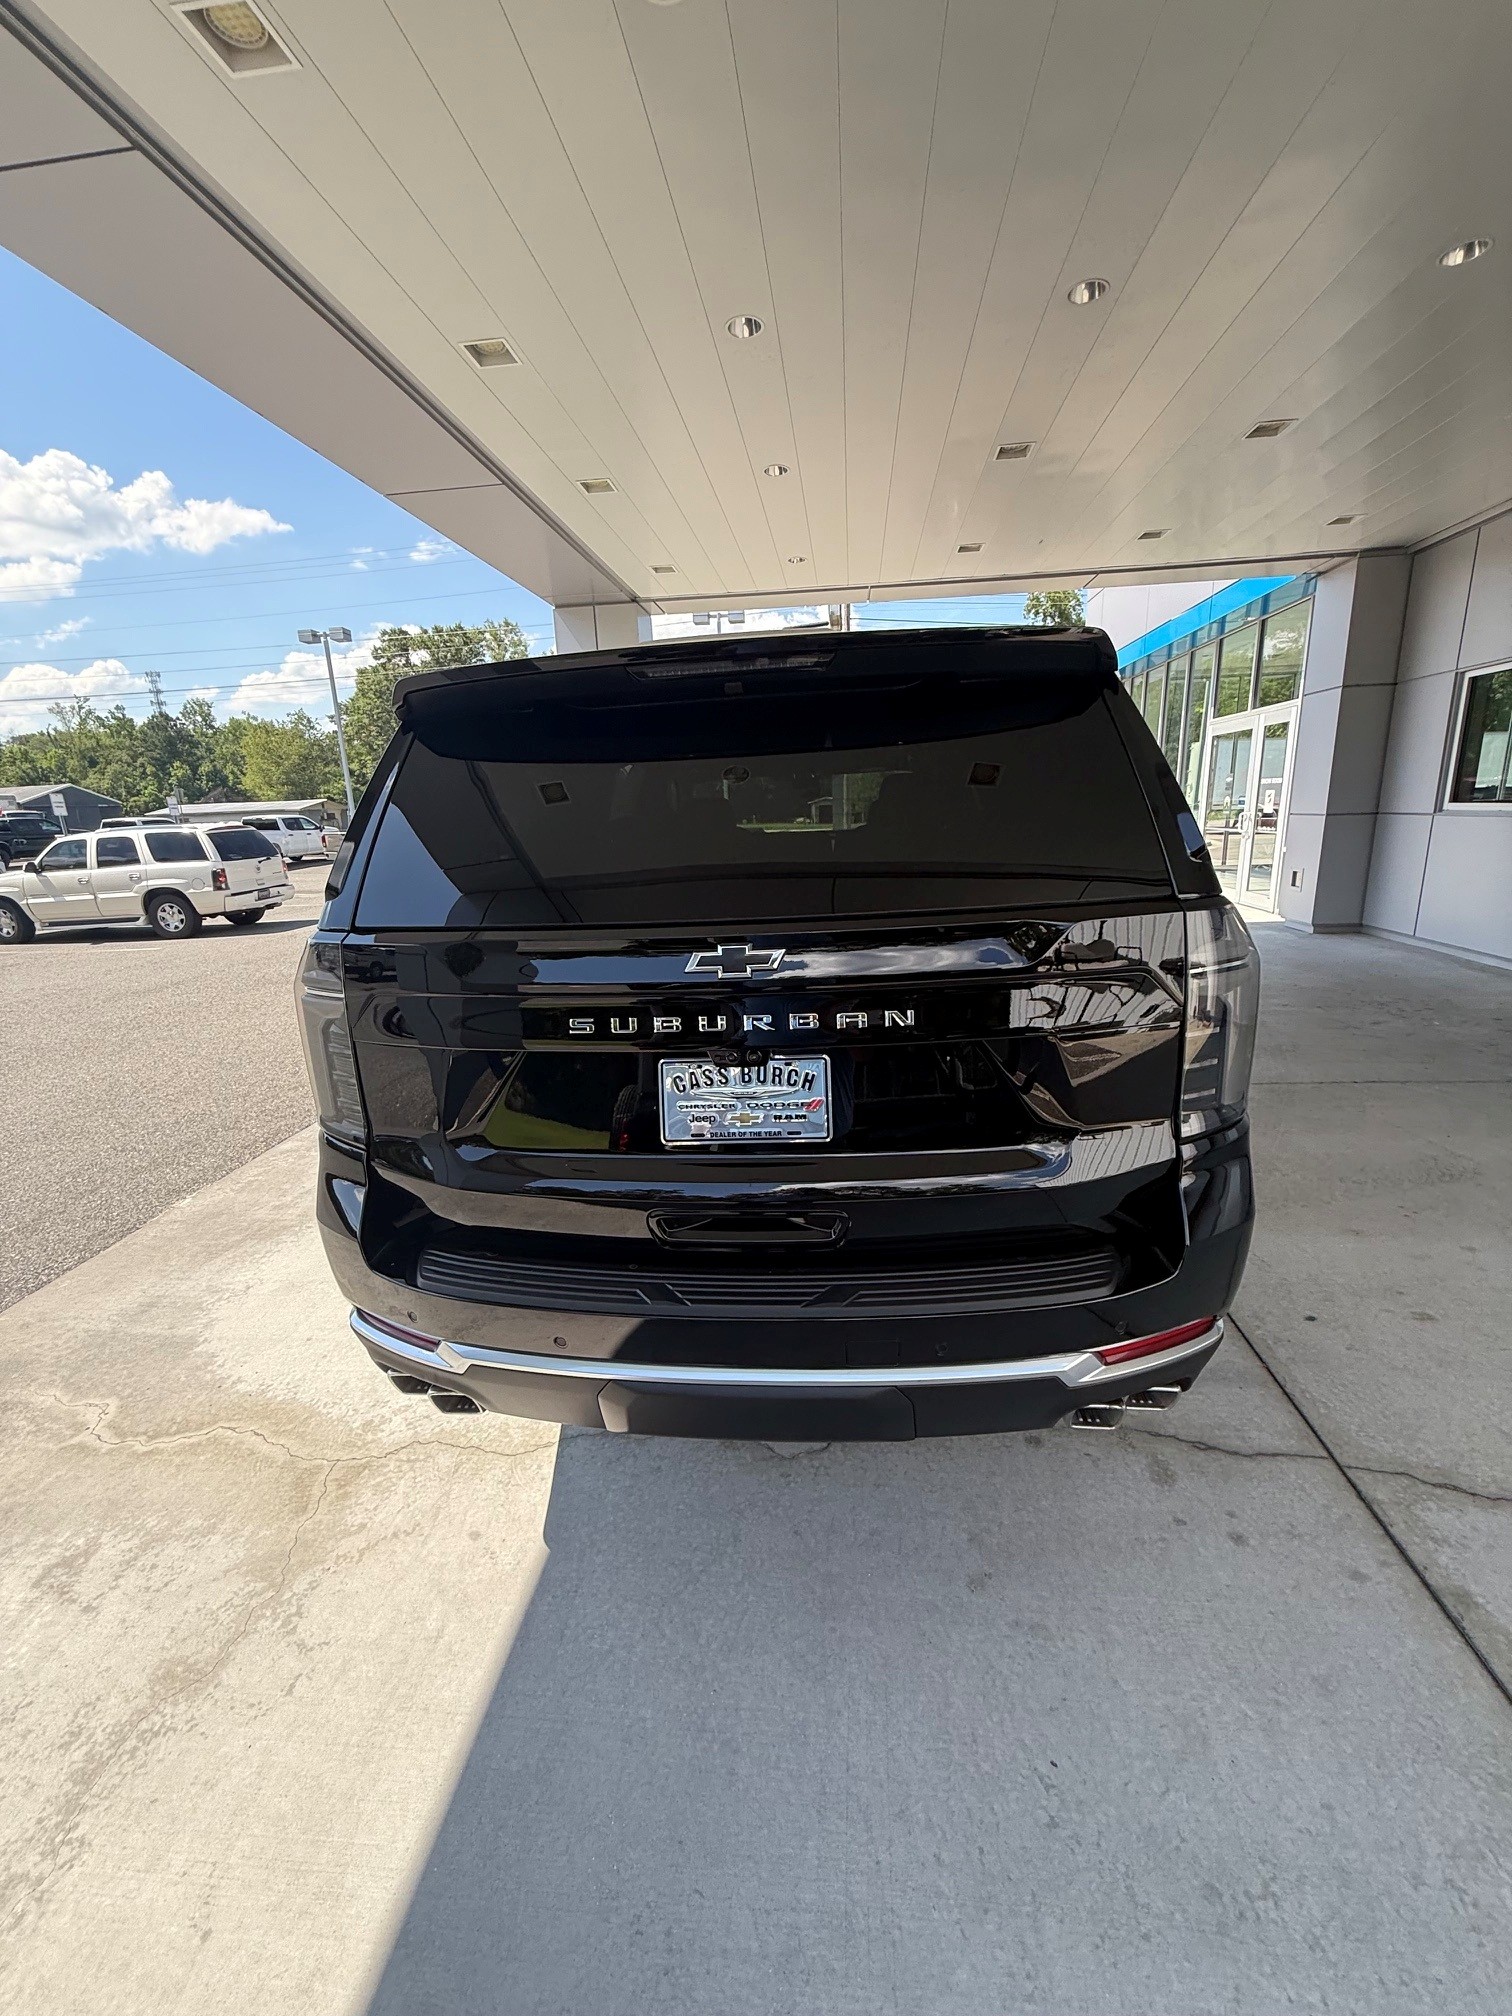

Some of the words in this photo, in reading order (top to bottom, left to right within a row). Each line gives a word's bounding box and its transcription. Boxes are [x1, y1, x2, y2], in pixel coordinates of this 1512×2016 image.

[568, 1010, 915, 1034] SUBURBAN
[674, 1067, 729, 1094] CASS
[741, 1066, 816, 1092] BURCH
[678, 1102, 736, 1110] CHRYSLER
[746, 1101, 812, 1109] DODGE
[688, 1114, 716, 1124] Jeep
[773, 1113, 807, 1121] RAM
